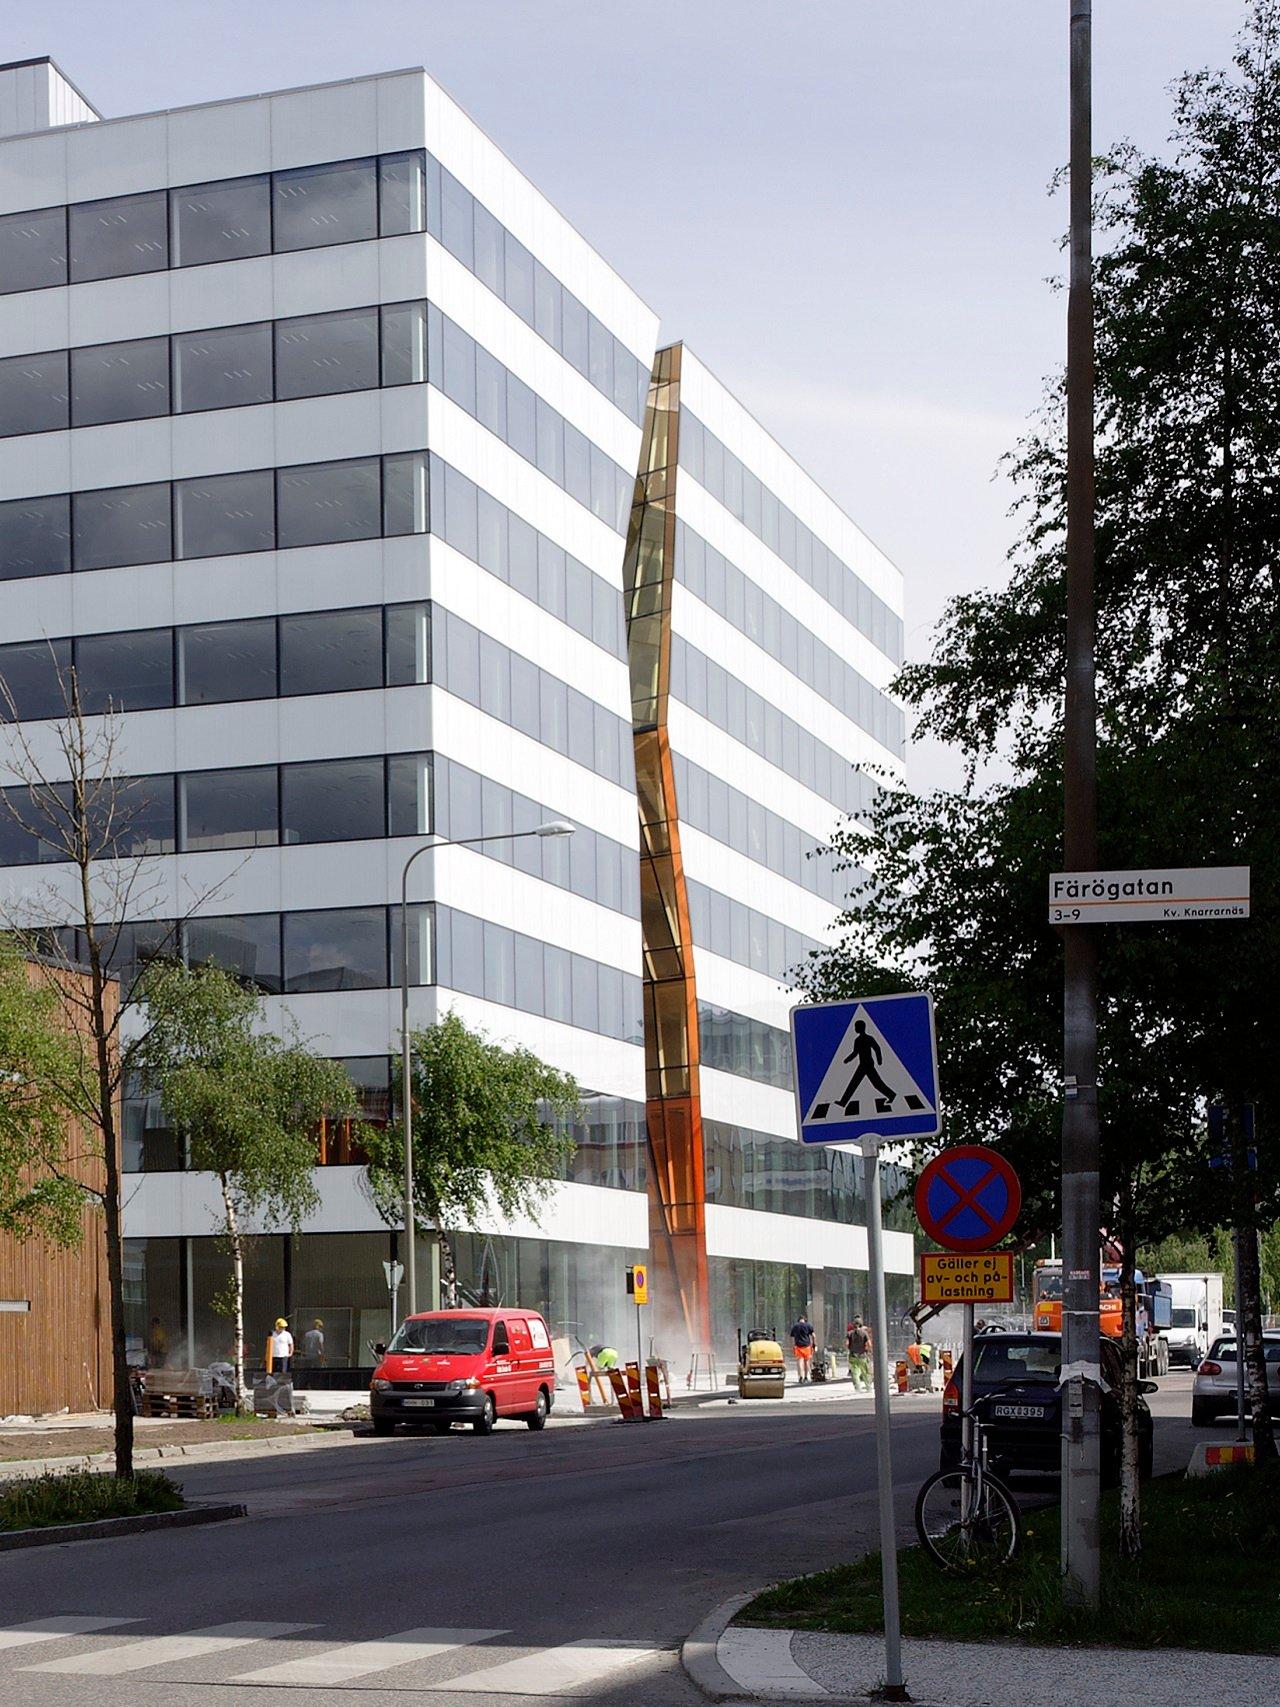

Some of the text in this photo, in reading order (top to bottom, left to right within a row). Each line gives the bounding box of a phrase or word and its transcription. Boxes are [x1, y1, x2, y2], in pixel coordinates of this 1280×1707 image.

[1054, 879, 1173, 900] Färögatan
[1054, 906, 1244, 921] 3-9 Kv. Knarrarnäs
[937, 1257, 997, 1271] Gäller ej
[926, 1271, 1007, 1285] av- och på-
[940, 1285, 994, 1298] lastning
[996, 1406, 1043, 1417] RGX 395
